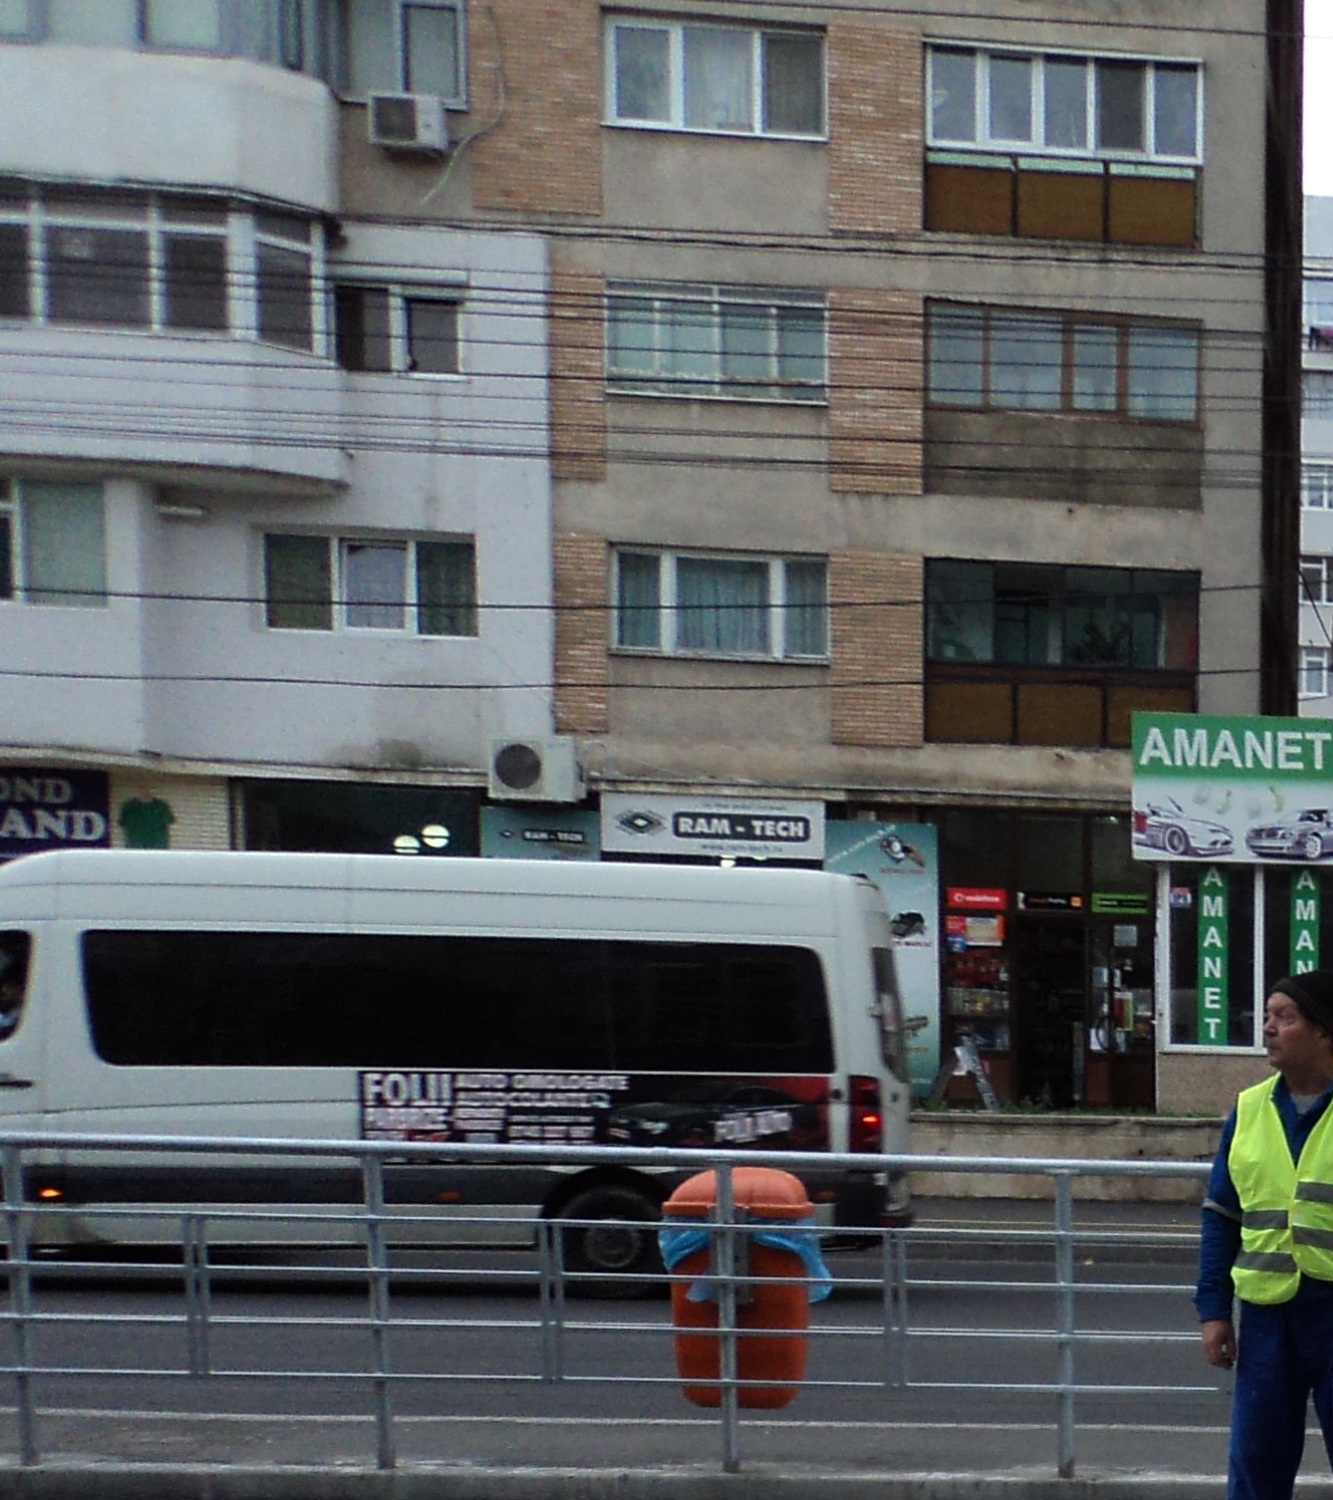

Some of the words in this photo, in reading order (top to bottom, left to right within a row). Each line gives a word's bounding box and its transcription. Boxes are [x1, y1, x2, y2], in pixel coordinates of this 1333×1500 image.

[1140, 727, 1332, 770] AMANET
[679, 817, 731, 835] RAM
[751, 820, 805, 837] TECH
[1202, 866, 1224, 1039] AMANET
[364, 1073, 451, 1106] FOLII
